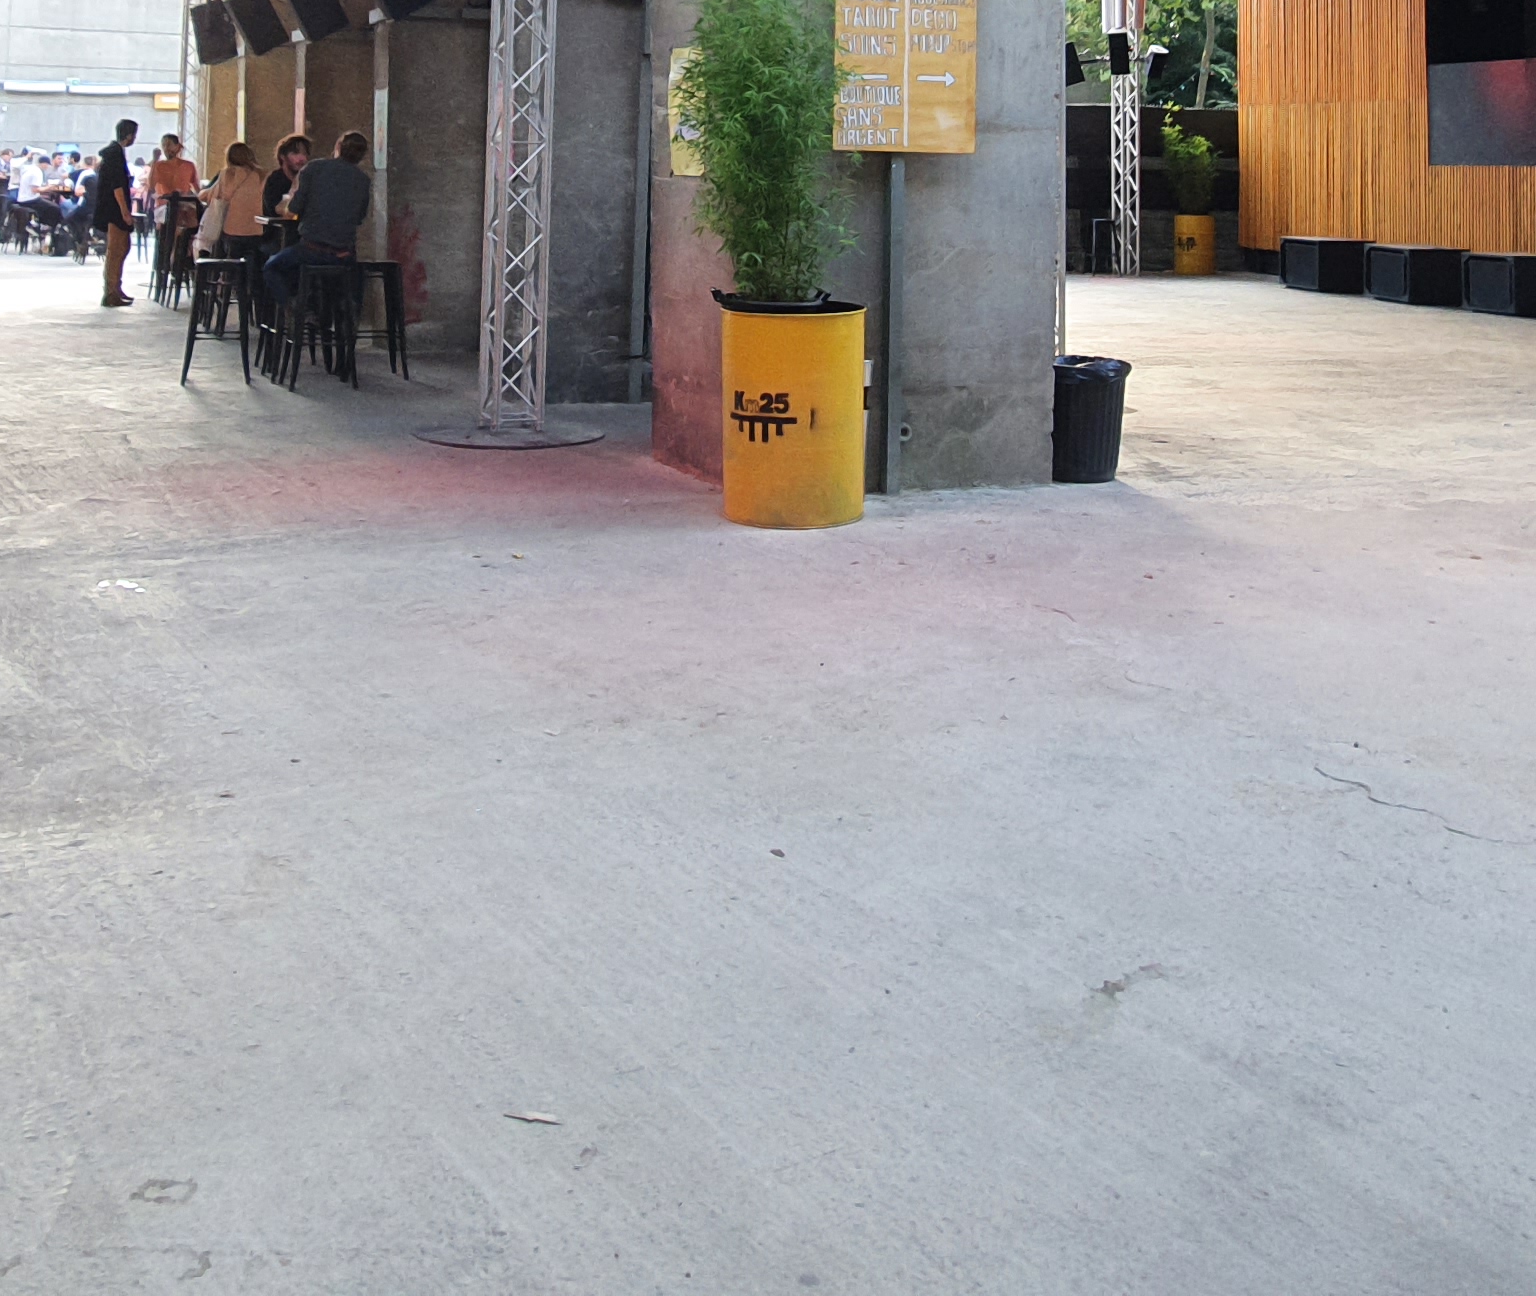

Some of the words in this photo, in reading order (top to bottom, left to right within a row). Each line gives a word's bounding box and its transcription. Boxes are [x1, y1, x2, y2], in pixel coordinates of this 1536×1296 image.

[842, 7, 900, 29] TAROT
[840, 32, 897, 56] SOINS
[839, 86, 901, 105] BOUTIQUE
[836, 106, 884, 129] SANS
[837, 128, 899, 146] ARGENT
[734, 390, 790, 414] Km25
